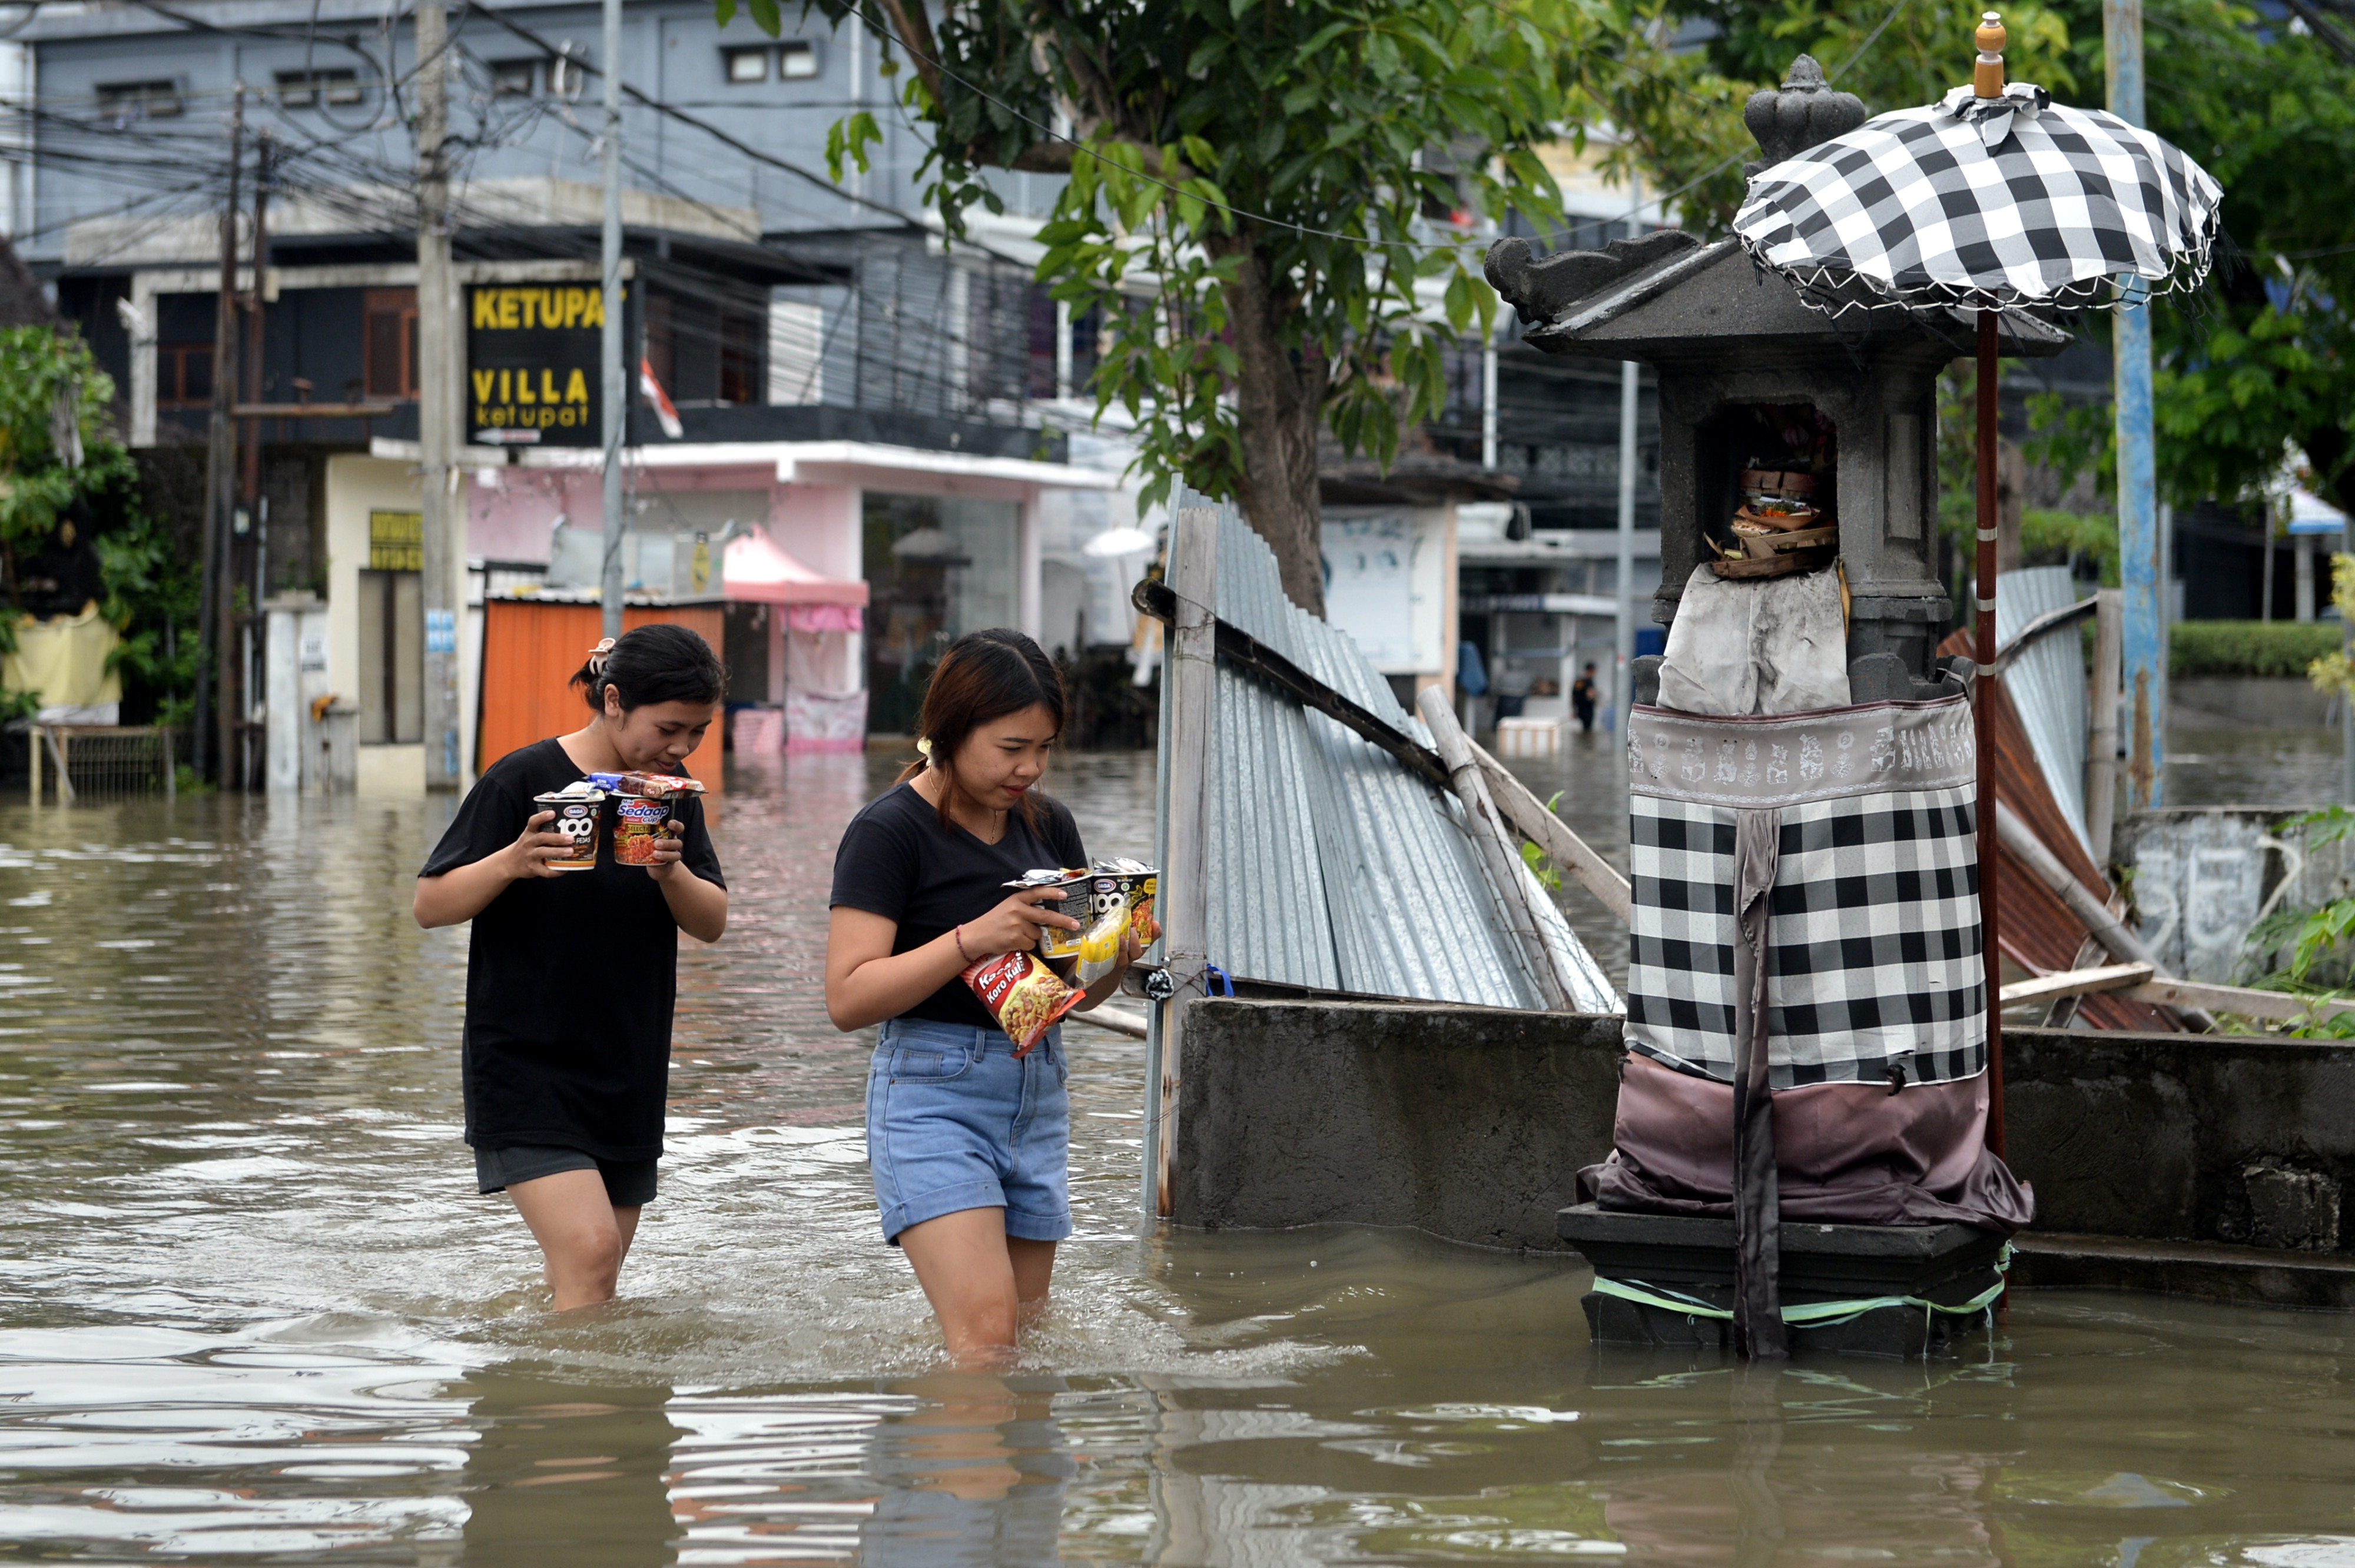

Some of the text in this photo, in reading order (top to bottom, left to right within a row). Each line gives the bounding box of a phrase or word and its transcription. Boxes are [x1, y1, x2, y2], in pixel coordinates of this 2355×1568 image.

[473, 288, 627, 329] KETUPA
[472, 367, 588, 404] VILLA
[556, 818, 593, 837] 100
[617, 805, 669, 818] Sedaap
[979, 951, 1023, 990] Kaca
[986, 959, 1026, 1004] Koro Kul
